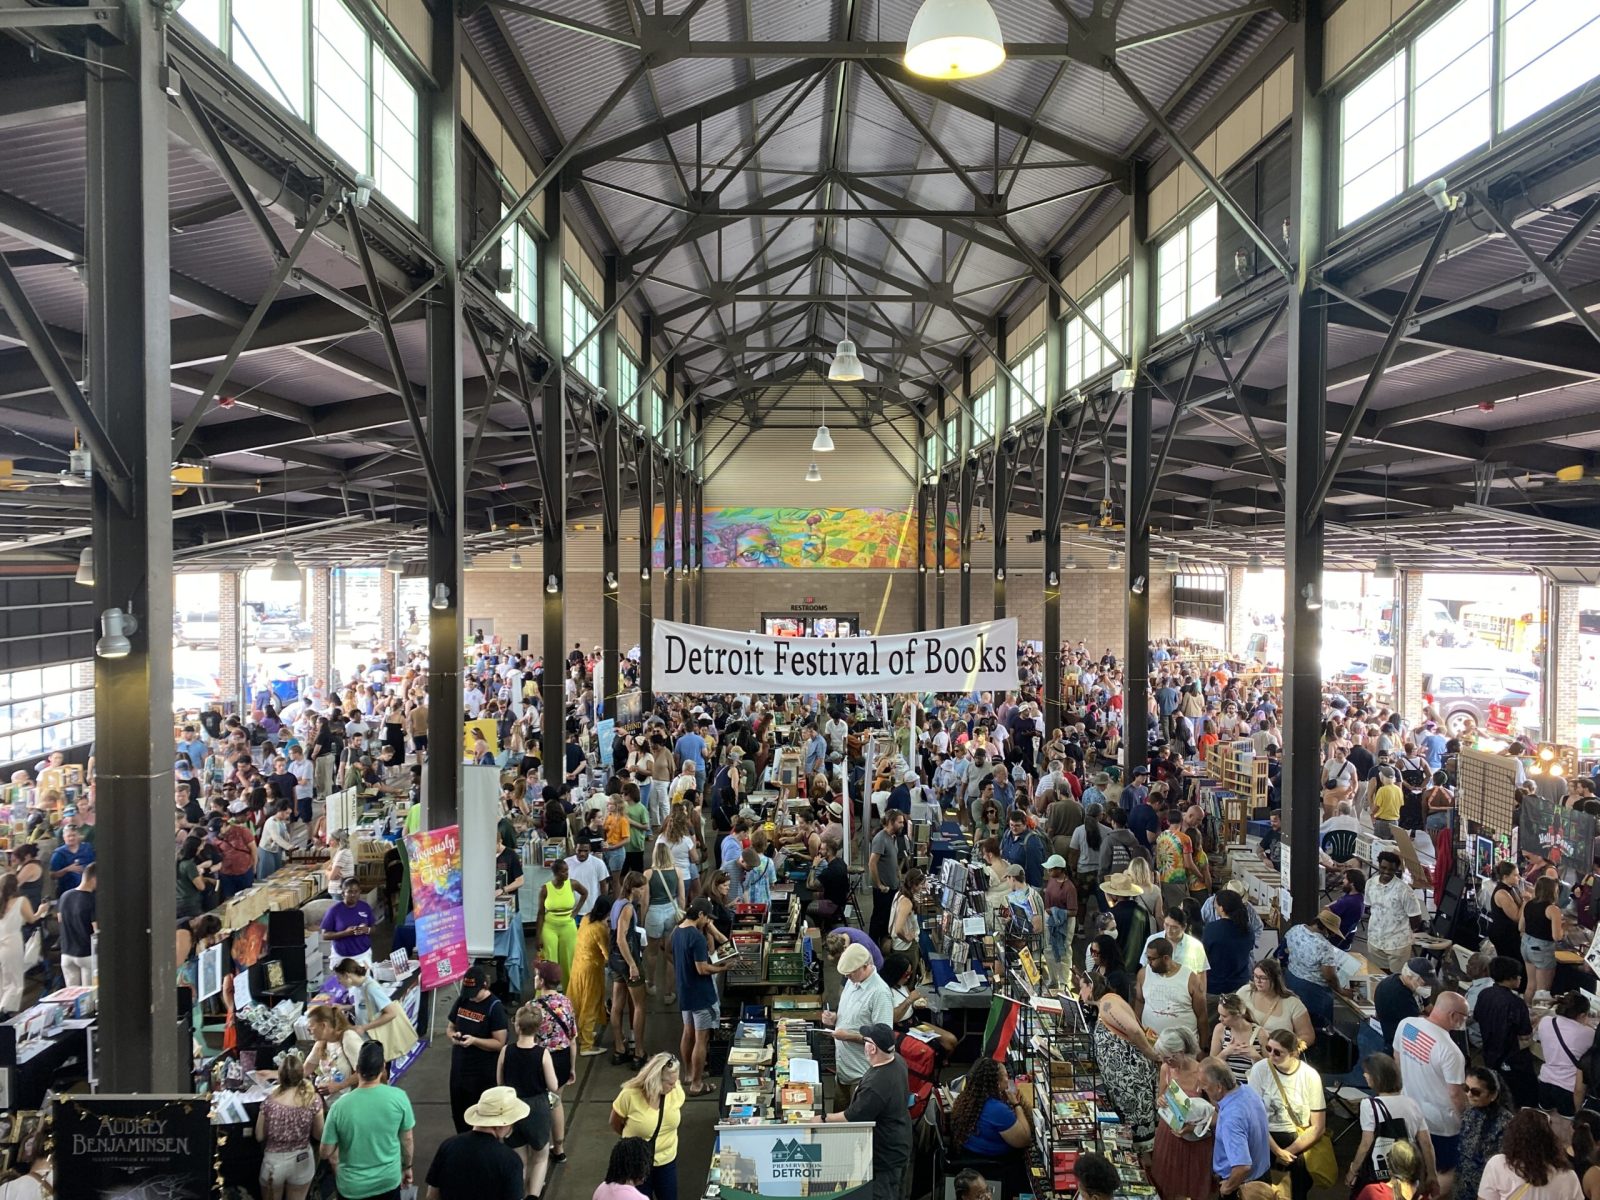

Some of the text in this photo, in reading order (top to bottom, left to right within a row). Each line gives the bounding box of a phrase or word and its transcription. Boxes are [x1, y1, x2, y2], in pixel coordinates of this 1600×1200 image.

[664, 632, 1007, 676] Detroit Festival of Books
[411, 833, 456, 867] Joyously
[421, 858, 452, 884] Free!
[72, 1133, 191, 1155] BENJAMINSEN
[772, 1169, 822, 1178] DETROIT
